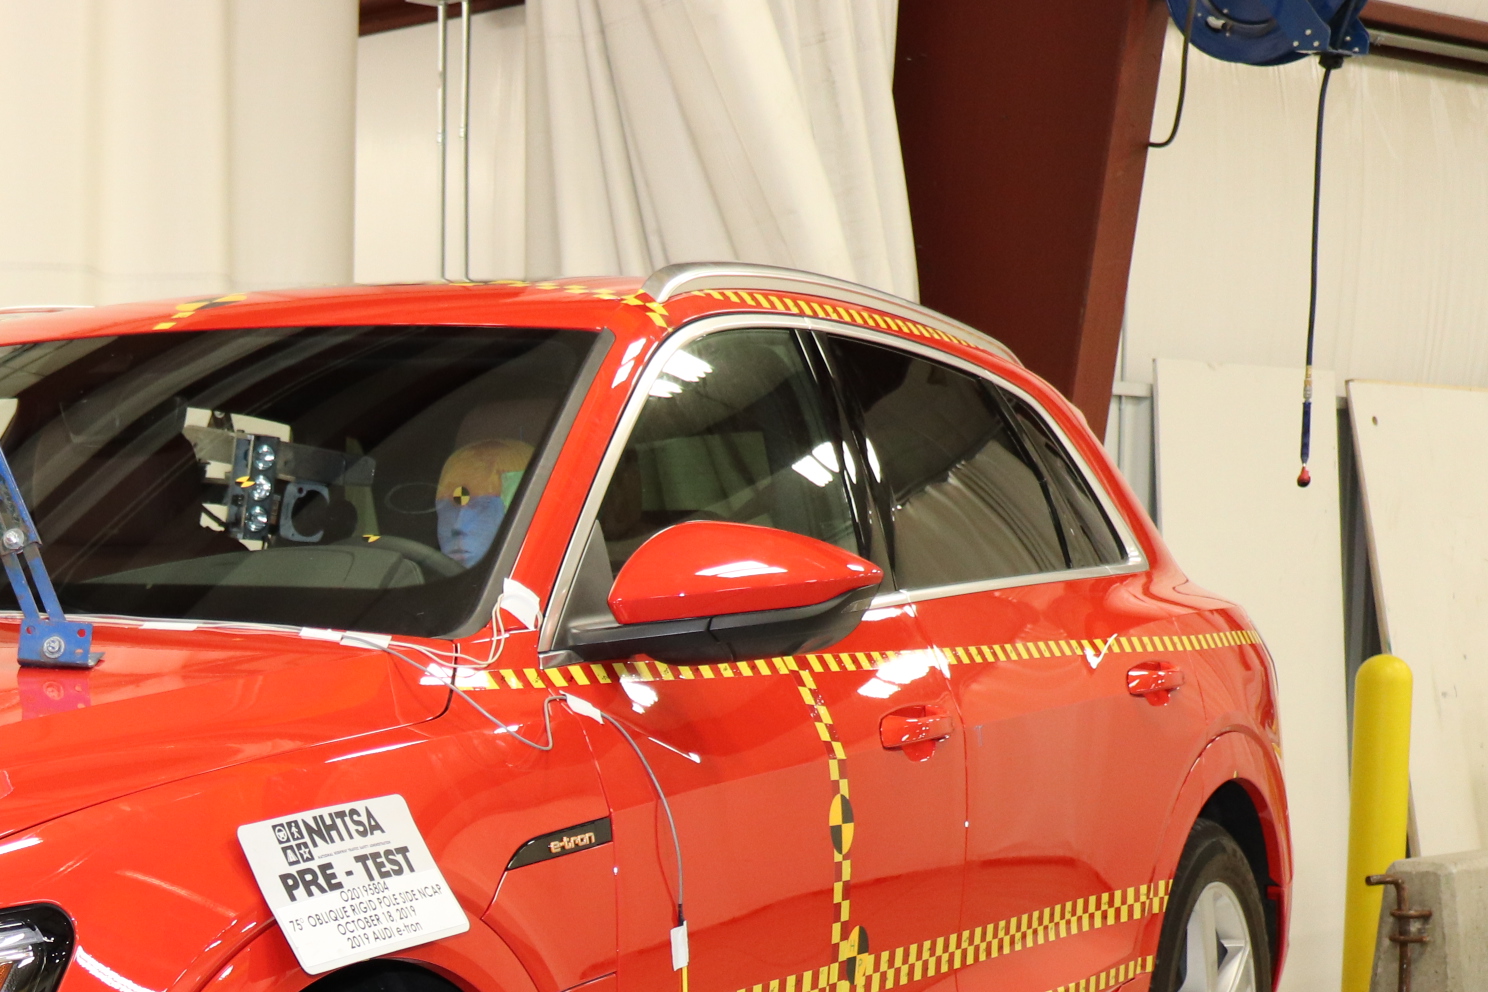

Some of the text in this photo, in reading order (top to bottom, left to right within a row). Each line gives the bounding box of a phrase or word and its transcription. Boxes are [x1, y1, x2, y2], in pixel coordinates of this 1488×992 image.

[301, 806, 386, 848] NHTSA
[550, 832, 595, 853] e-tron
[308, 906, 350, 928] OBLIQUE
[350, 899, 377, 916] RIGID
[377, 894, 400, 909] POLE
[400, 889, 419, 904] SIDE
[419, 884, 443, 901] NCAP
[337, 905, 417, 935] OCTOBER 18, 2019
[347, 922, 423, 949] 2019 AUDI e-tron
